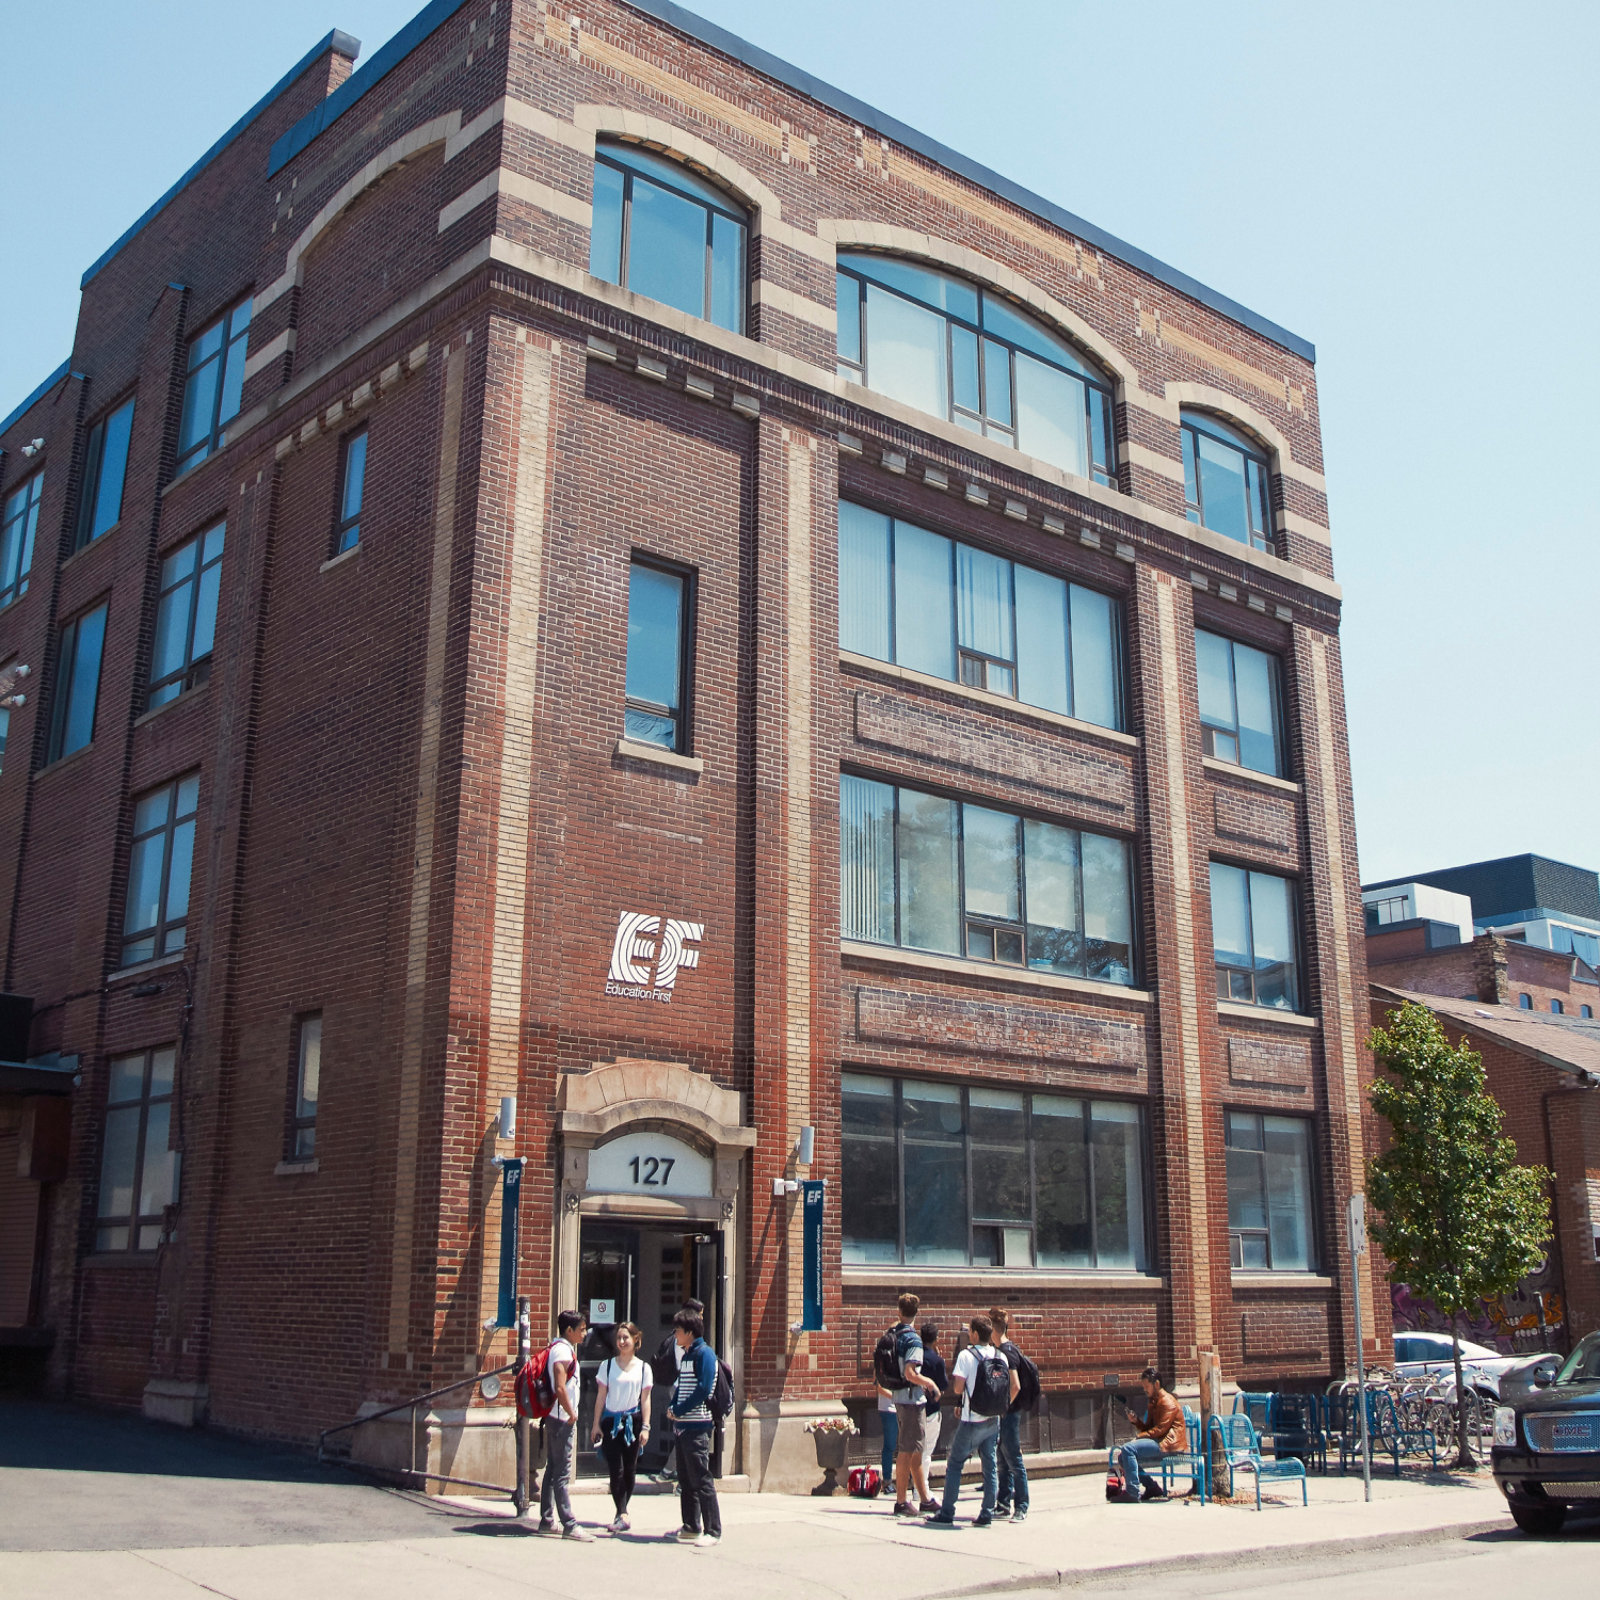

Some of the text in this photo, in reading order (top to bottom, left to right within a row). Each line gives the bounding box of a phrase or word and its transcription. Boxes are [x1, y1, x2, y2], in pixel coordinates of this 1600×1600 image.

[608, 910, 705, 989] EF
[605, 982, 672, 1003] Education First
[506, 1169, 520, 1184] EF
[629, 1156, 676, 1185] 127
[807, 1190, 821, 1204] EF
[1553, 1426, 1591, 1437] GMC
